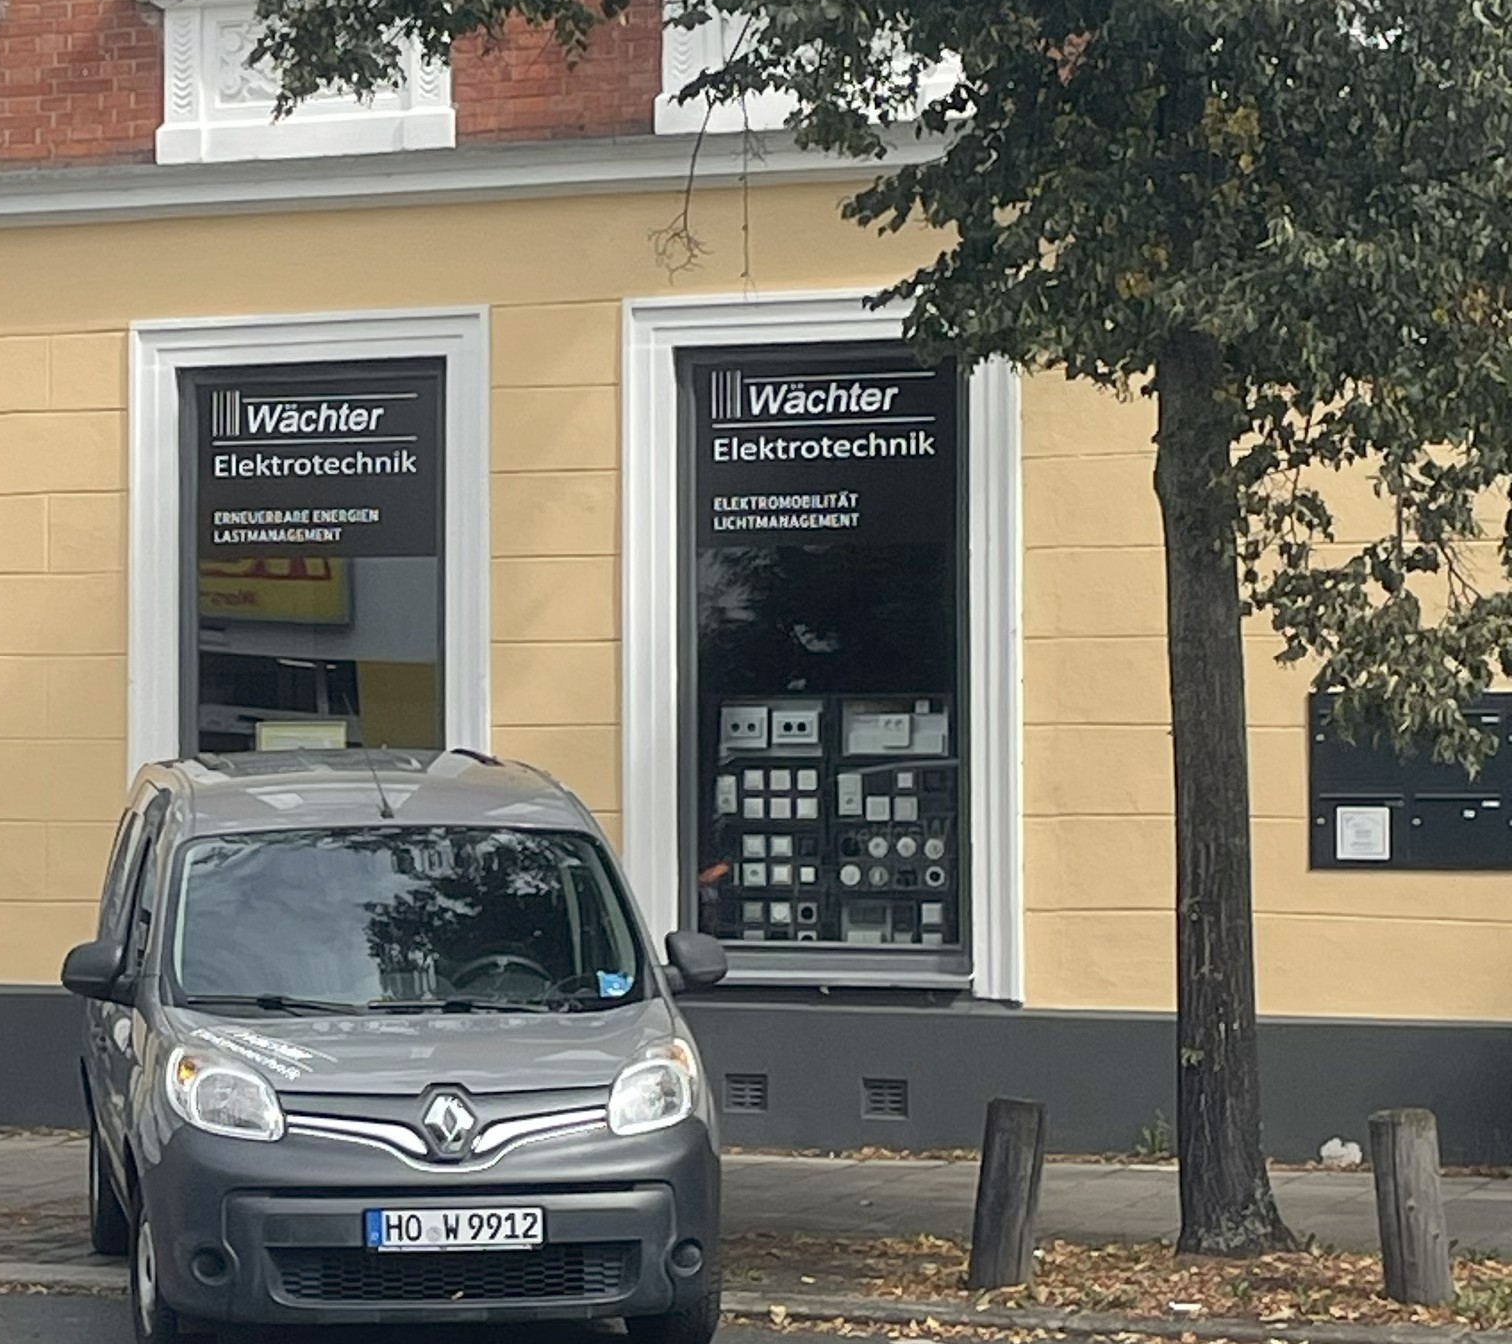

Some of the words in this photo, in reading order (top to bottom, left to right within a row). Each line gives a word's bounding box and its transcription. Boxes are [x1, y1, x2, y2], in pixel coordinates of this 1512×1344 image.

[749, 382, 899, 416] Wächter
[247, 403, 384, 434] Wächter
[713, 431, 936, 461] Elektrotechnik
[214, 450, 417, 477] Elektrotechnik
[713, 491, 859, 511] ELEKTROMOBILITÄT
[213, 510, 309, 525] ERNEUERBARE
[312, 508, 380, 523] ENERGIEN
[713, 513, 859, 531] LICHTMANAGEMENT
[213, 527, 342, 543] LASTMANAGEMENT
[385, 1213, 423, 1242] HO
[442, 1213, 460, 1240] W
[467, 1212, 538, 1241] 9912
